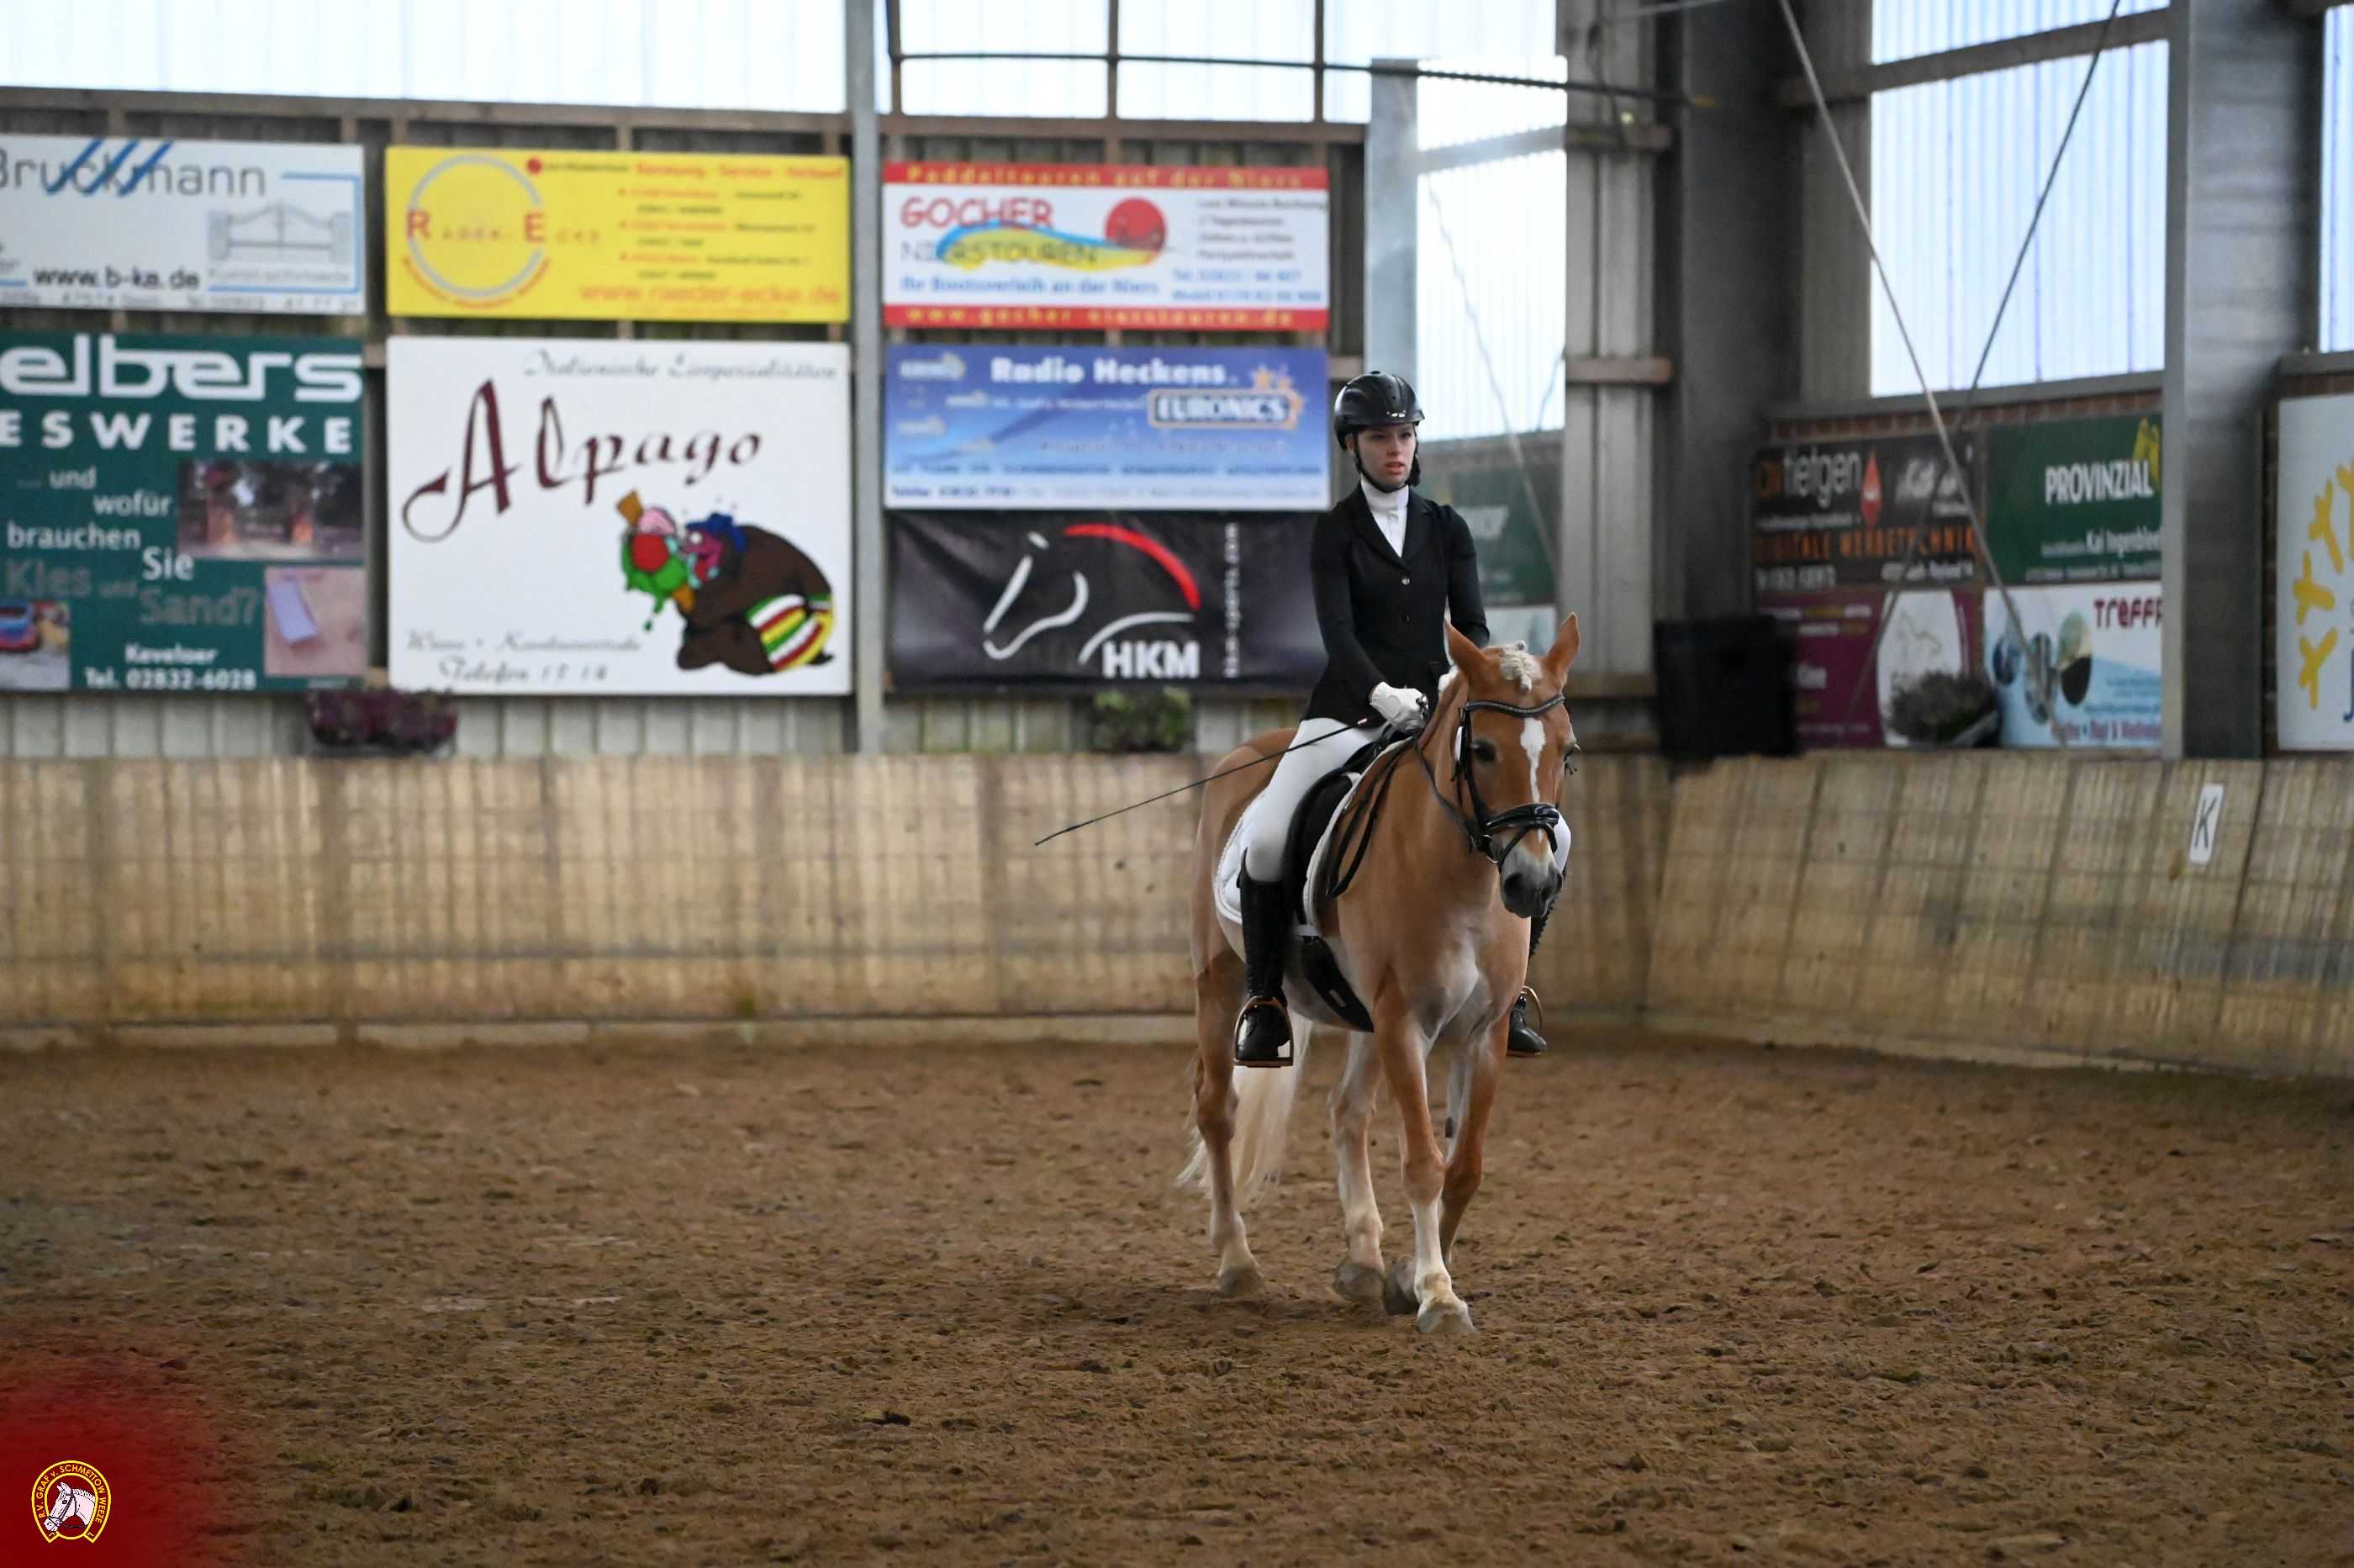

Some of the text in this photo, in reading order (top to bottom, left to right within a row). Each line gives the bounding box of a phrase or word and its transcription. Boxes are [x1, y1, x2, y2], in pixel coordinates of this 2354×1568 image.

[900, 196, 1054, 229] GOCHER
[0, 334, 362, 403] elbers
[990, 356, 1085, 384] Radio
[49, 464, 97, 489] und
[402, 378, 762, 542] Alpago
[2045, 459, 2154, 506] PROVINZIAL
[92, 488, 172, 517] wofür
[8, 520, 141, 549] brauchen
[142, 546, 194, 581] Sie
[1101, 641, 1201, 679] HKM
[2194, 796, 2218, 849] K
